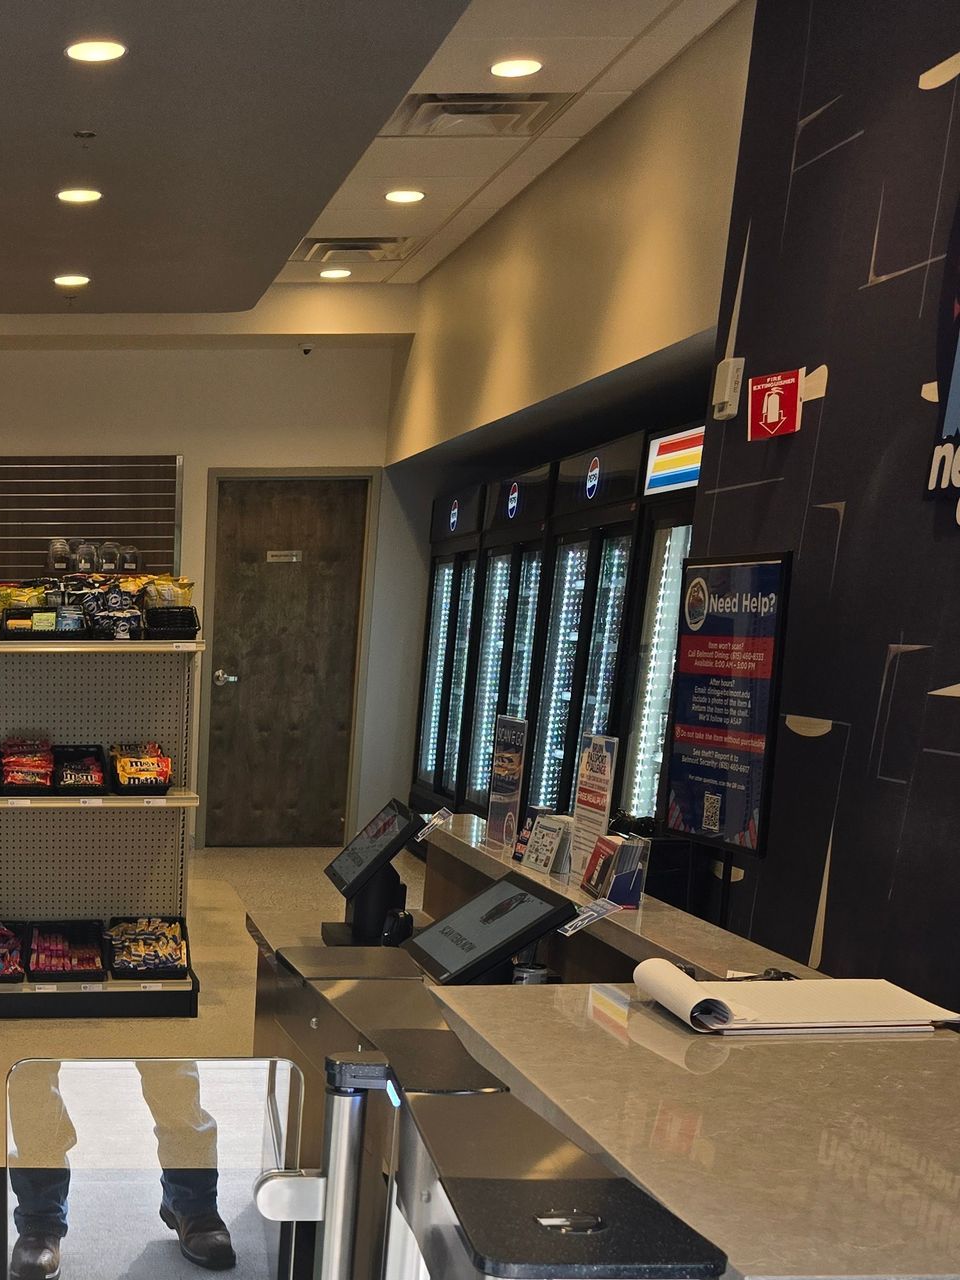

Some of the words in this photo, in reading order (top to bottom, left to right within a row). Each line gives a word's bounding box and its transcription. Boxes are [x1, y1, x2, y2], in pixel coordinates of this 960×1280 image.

[753, 378, 796, 391] EXTINGUISHER
[766, 375, 782, 383] FIRE
[709, 593, 739, 613] Need
[742, 592, 776, 617] Help?
[498, 727, 512, 742] SCAN
